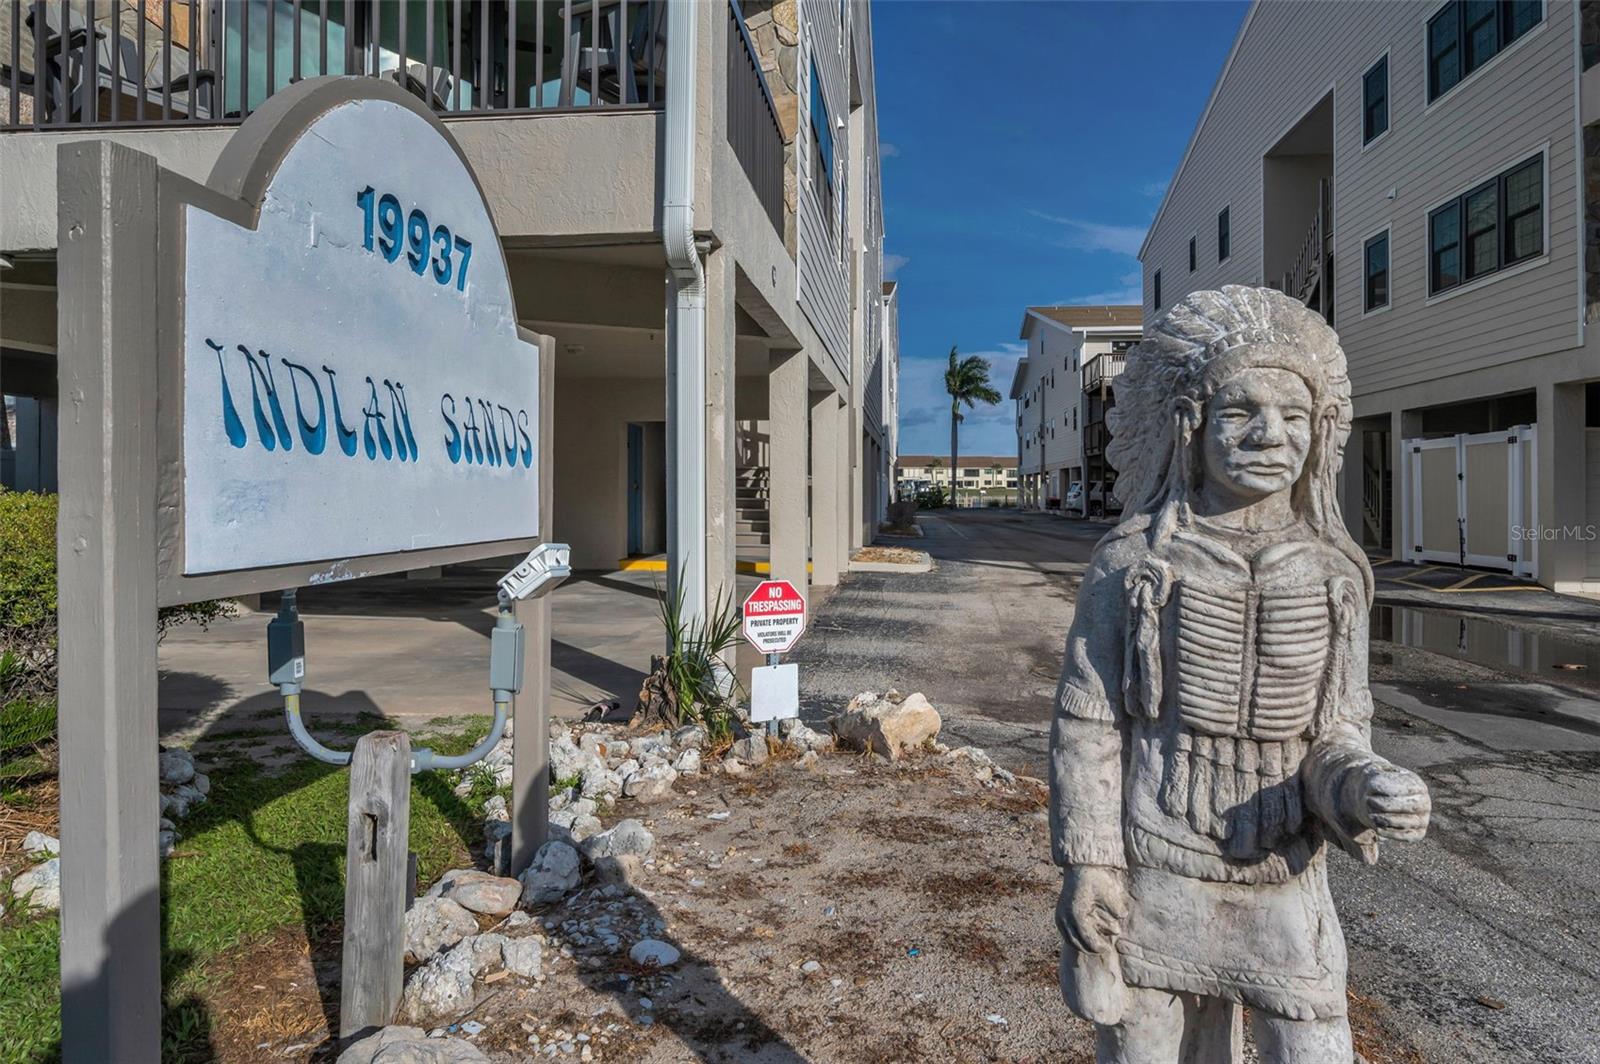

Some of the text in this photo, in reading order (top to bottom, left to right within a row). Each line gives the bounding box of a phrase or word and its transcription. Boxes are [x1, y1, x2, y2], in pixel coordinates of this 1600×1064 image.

[357, 185, 473, 292] 19937
[441, 392, 533, 469] SANDS
[768, 587, 783, 598] NO
[748, 599, 802, 613] TRESPASSING
[750, 617, 799, 628] PRIVATE PROPERTY
[757, 630, 778, 638] VIOLATORS
